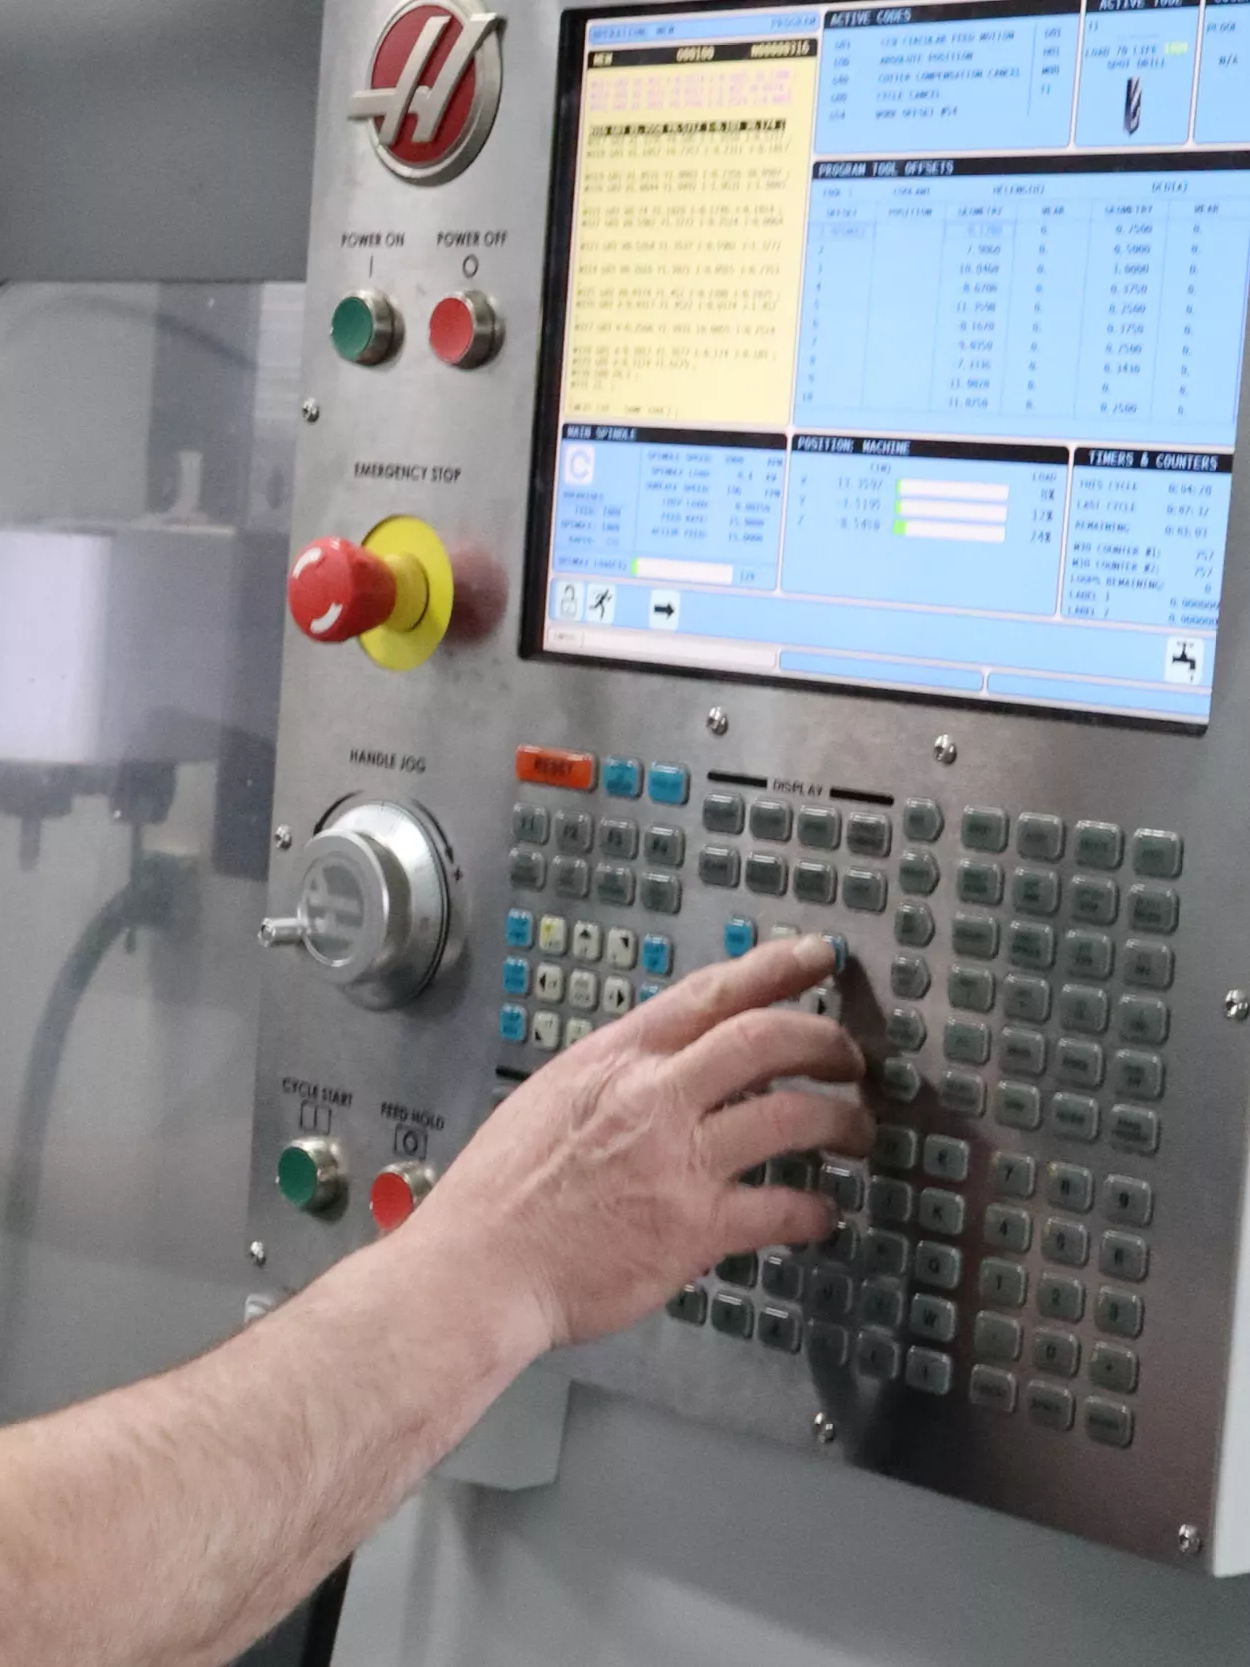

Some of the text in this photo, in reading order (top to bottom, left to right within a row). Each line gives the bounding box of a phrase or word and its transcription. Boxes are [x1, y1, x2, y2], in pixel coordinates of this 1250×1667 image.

[830, 10, 871, 27] ACTIVE
[818, 159, 955, 177] PROGRAM TOOL OFFSETS
[341, 232, 405, 248] POWER ON
[437, 230, 508, 247] POWER OFF
[566, 425, 592, 438] MAIN
[862, 440, 911, 456] MACHINE
[1089, 450, 1134, 467] TIMERS
[1155, 453, 1219, 471] COUNTERS
[354, 461, 462, 483] EMERGENCY STOP
[350, 749, 426, 773] HANDLE JOG
[773, 778, 824, 797] DISPLAY
[282, 1077, 353, 1106] CYCLE START
[380, 1101, 445, 1130] FEED HOLD
